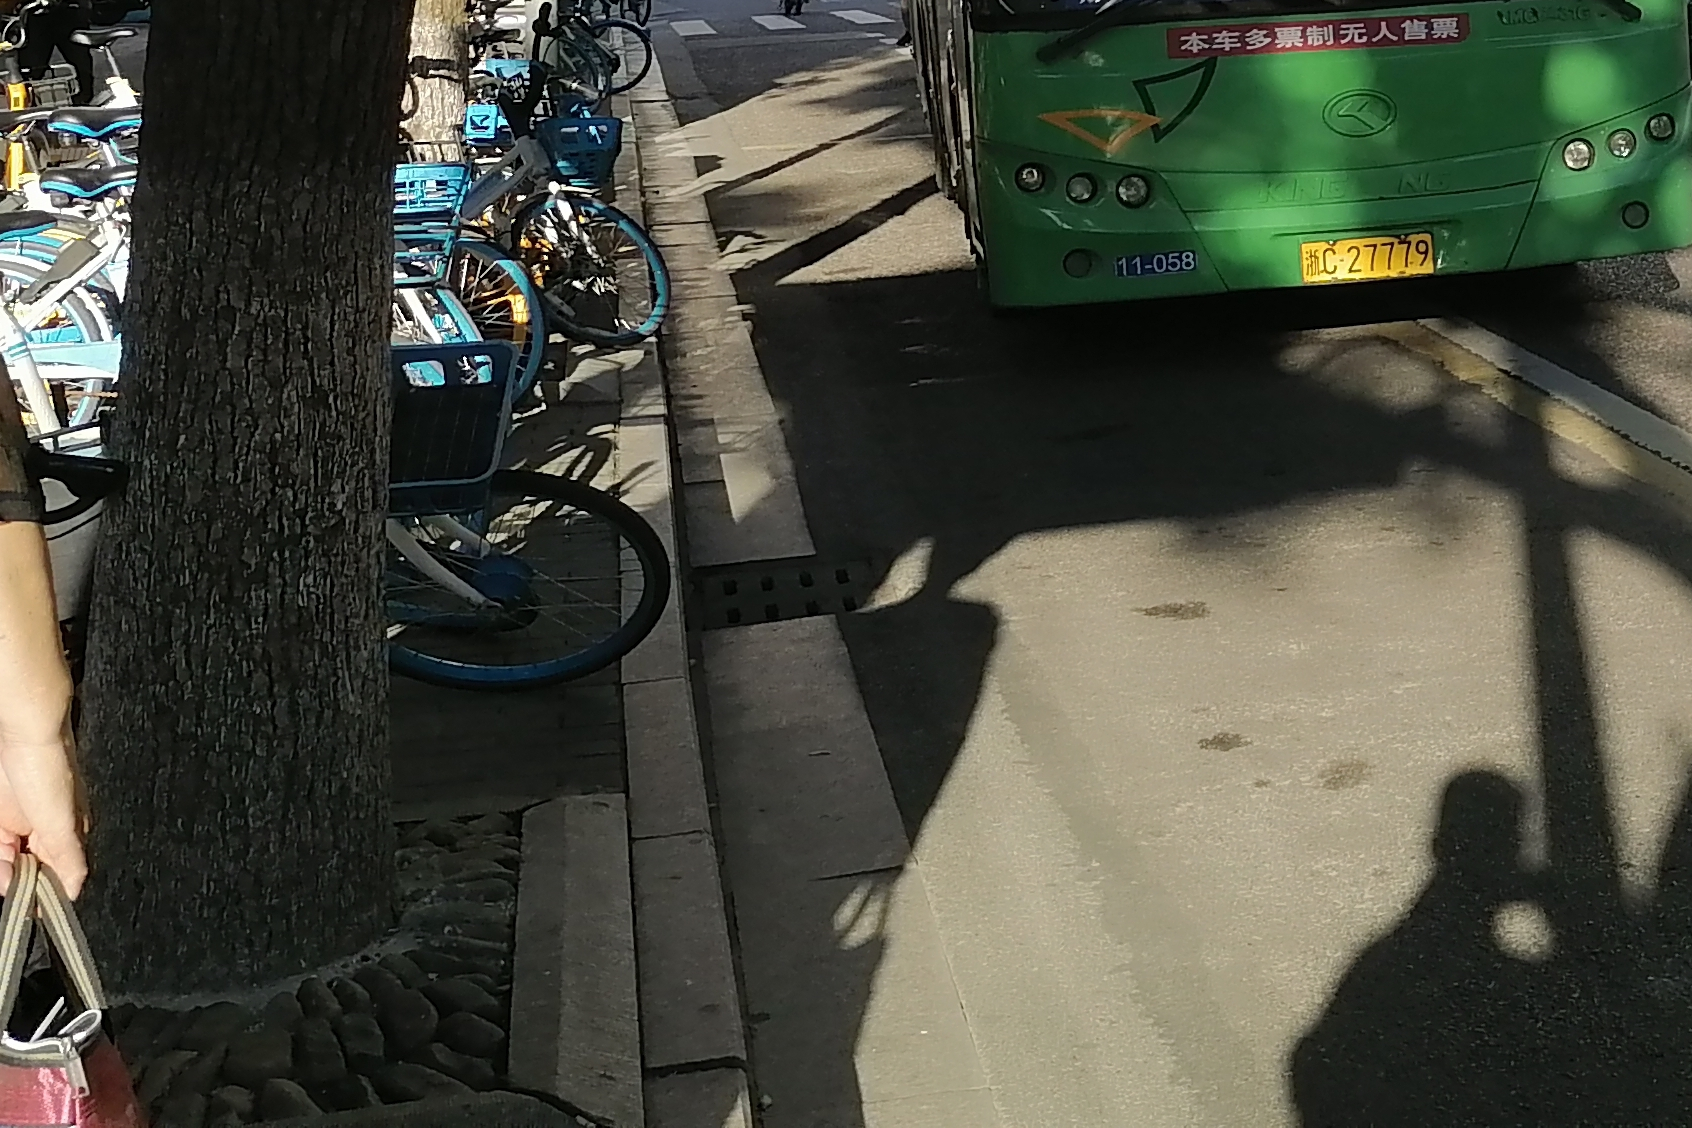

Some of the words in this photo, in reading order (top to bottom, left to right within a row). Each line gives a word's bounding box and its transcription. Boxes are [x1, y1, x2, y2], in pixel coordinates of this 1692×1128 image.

[1180, 17, 1459, 54] 本车多票制无人售票
[1118, 251, 1195, 276] 11-058
